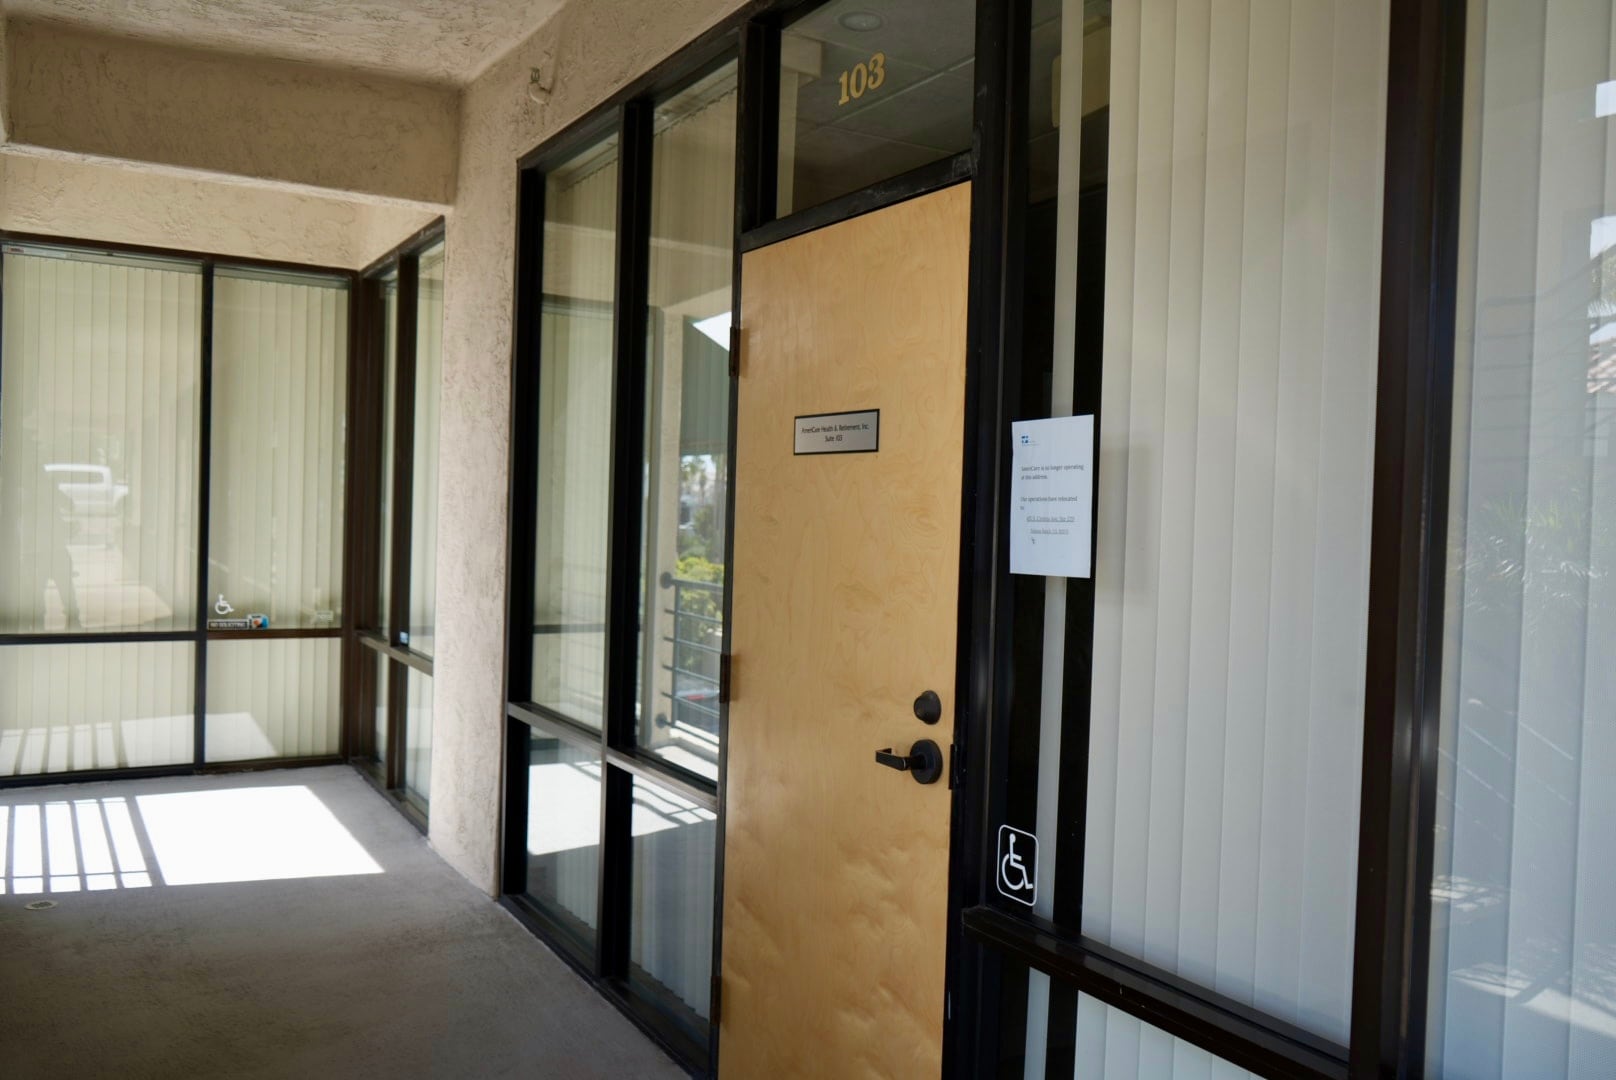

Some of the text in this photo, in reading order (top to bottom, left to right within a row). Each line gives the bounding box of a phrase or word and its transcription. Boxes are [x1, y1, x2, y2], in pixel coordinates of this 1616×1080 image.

[838, 52, 885, 106] 103
[802, 426, 820, 434] AmeriCare
[821, 425, 833, 433] Health
[839, 423, 860, 432] Retirement,
[825, 434, 844, 443] Suite 103
[1050, 465, 1063, 473] longer
[1064, 464, 1085, 472] operating
